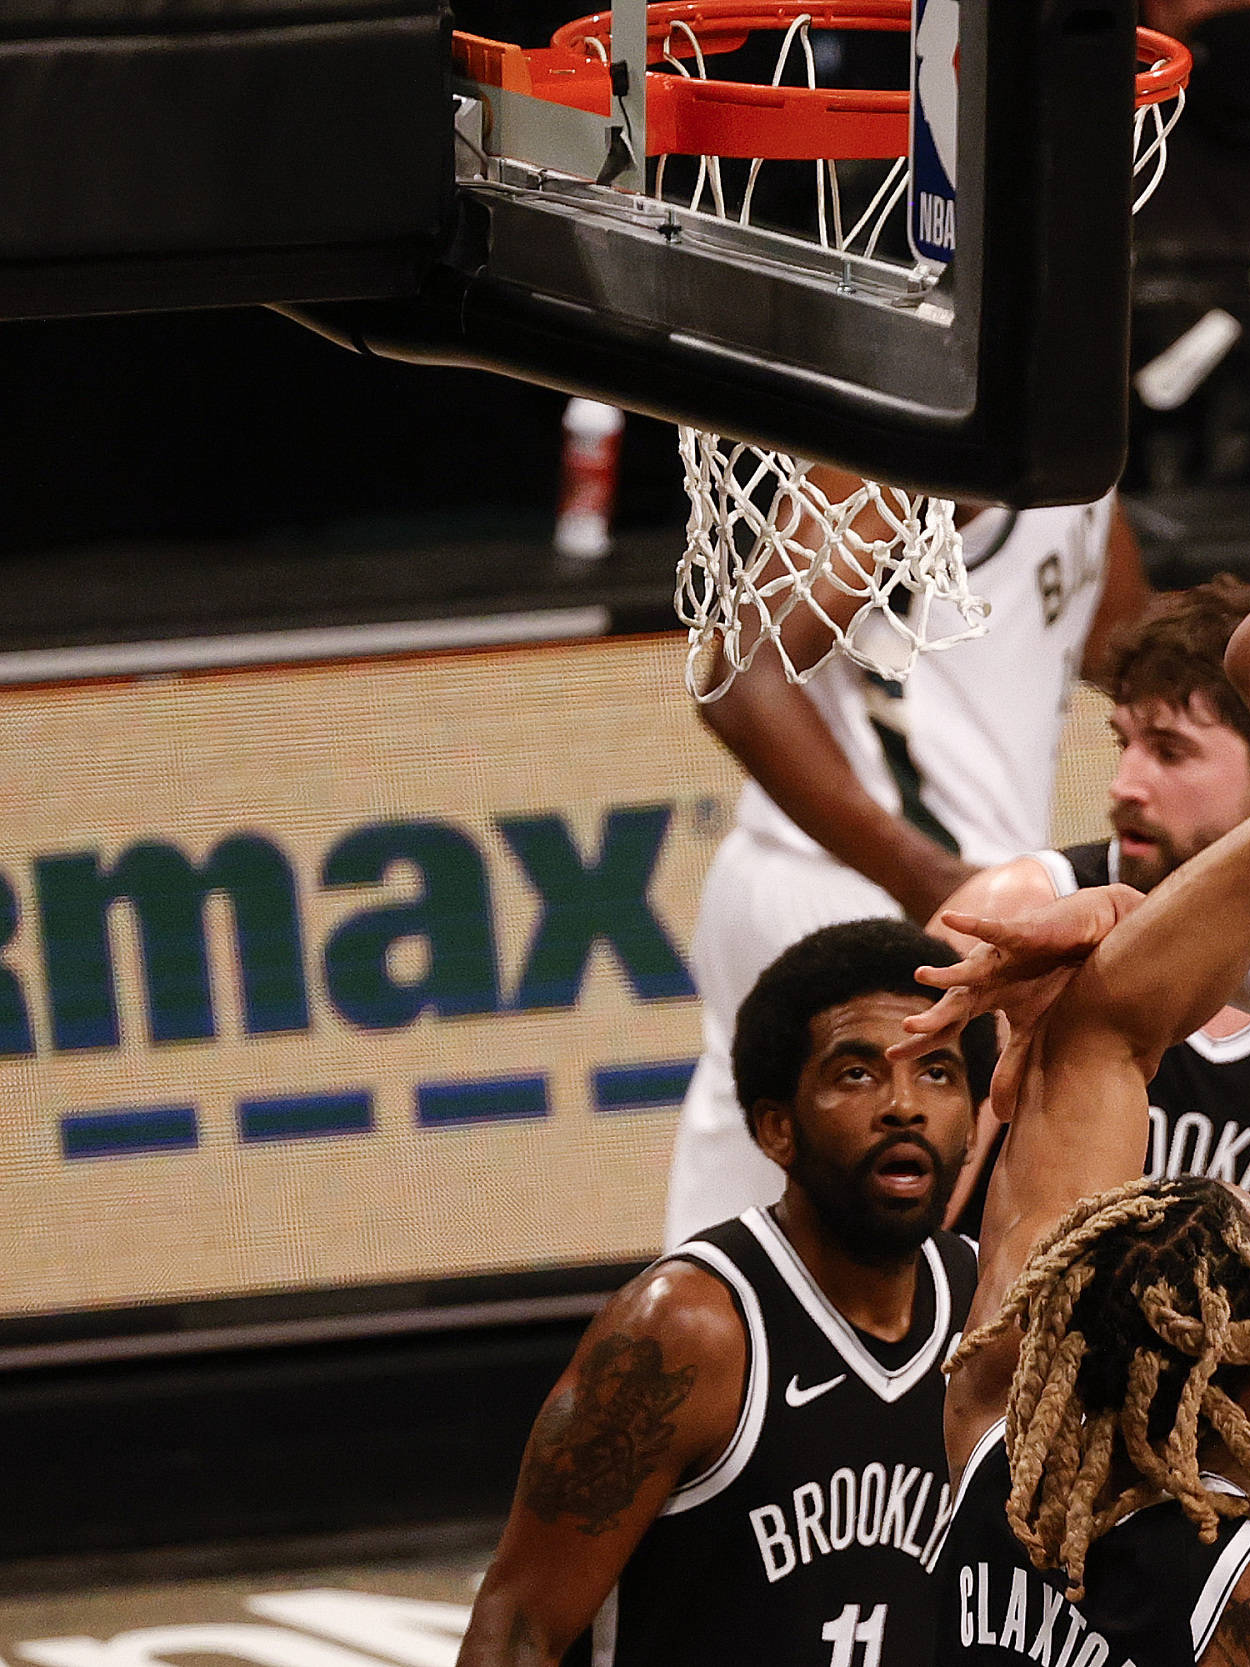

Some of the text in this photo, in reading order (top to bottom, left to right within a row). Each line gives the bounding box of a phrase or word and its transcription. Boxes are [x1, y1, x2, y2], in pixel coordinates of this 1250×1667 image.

[919, 191, 957, 251] NBA
[821, 1603, 888, 1667] 11
[959, 1562, 1136, 1667] CLAXTO
